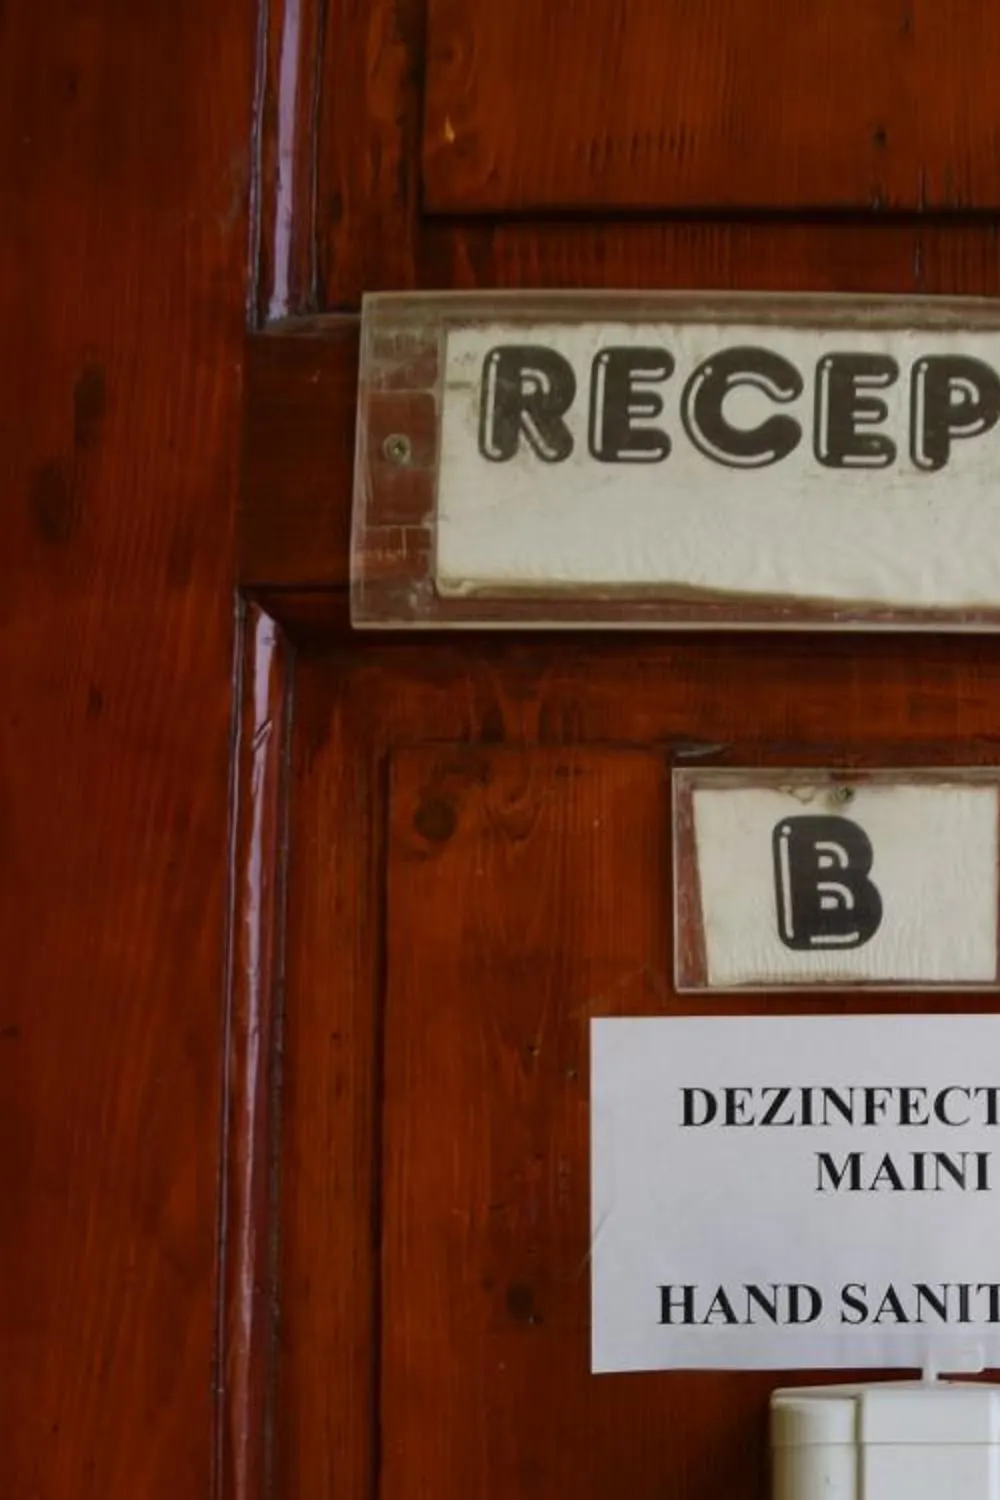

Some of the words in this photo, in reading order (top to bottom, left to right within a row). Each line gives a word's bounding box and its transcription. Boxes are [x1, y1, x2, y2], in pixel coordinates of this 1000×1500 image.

[771, 814, 883, 951] B
[815, 1151, 992, 1191] MAINI
[657, 1284, 822, 1324] HAND
